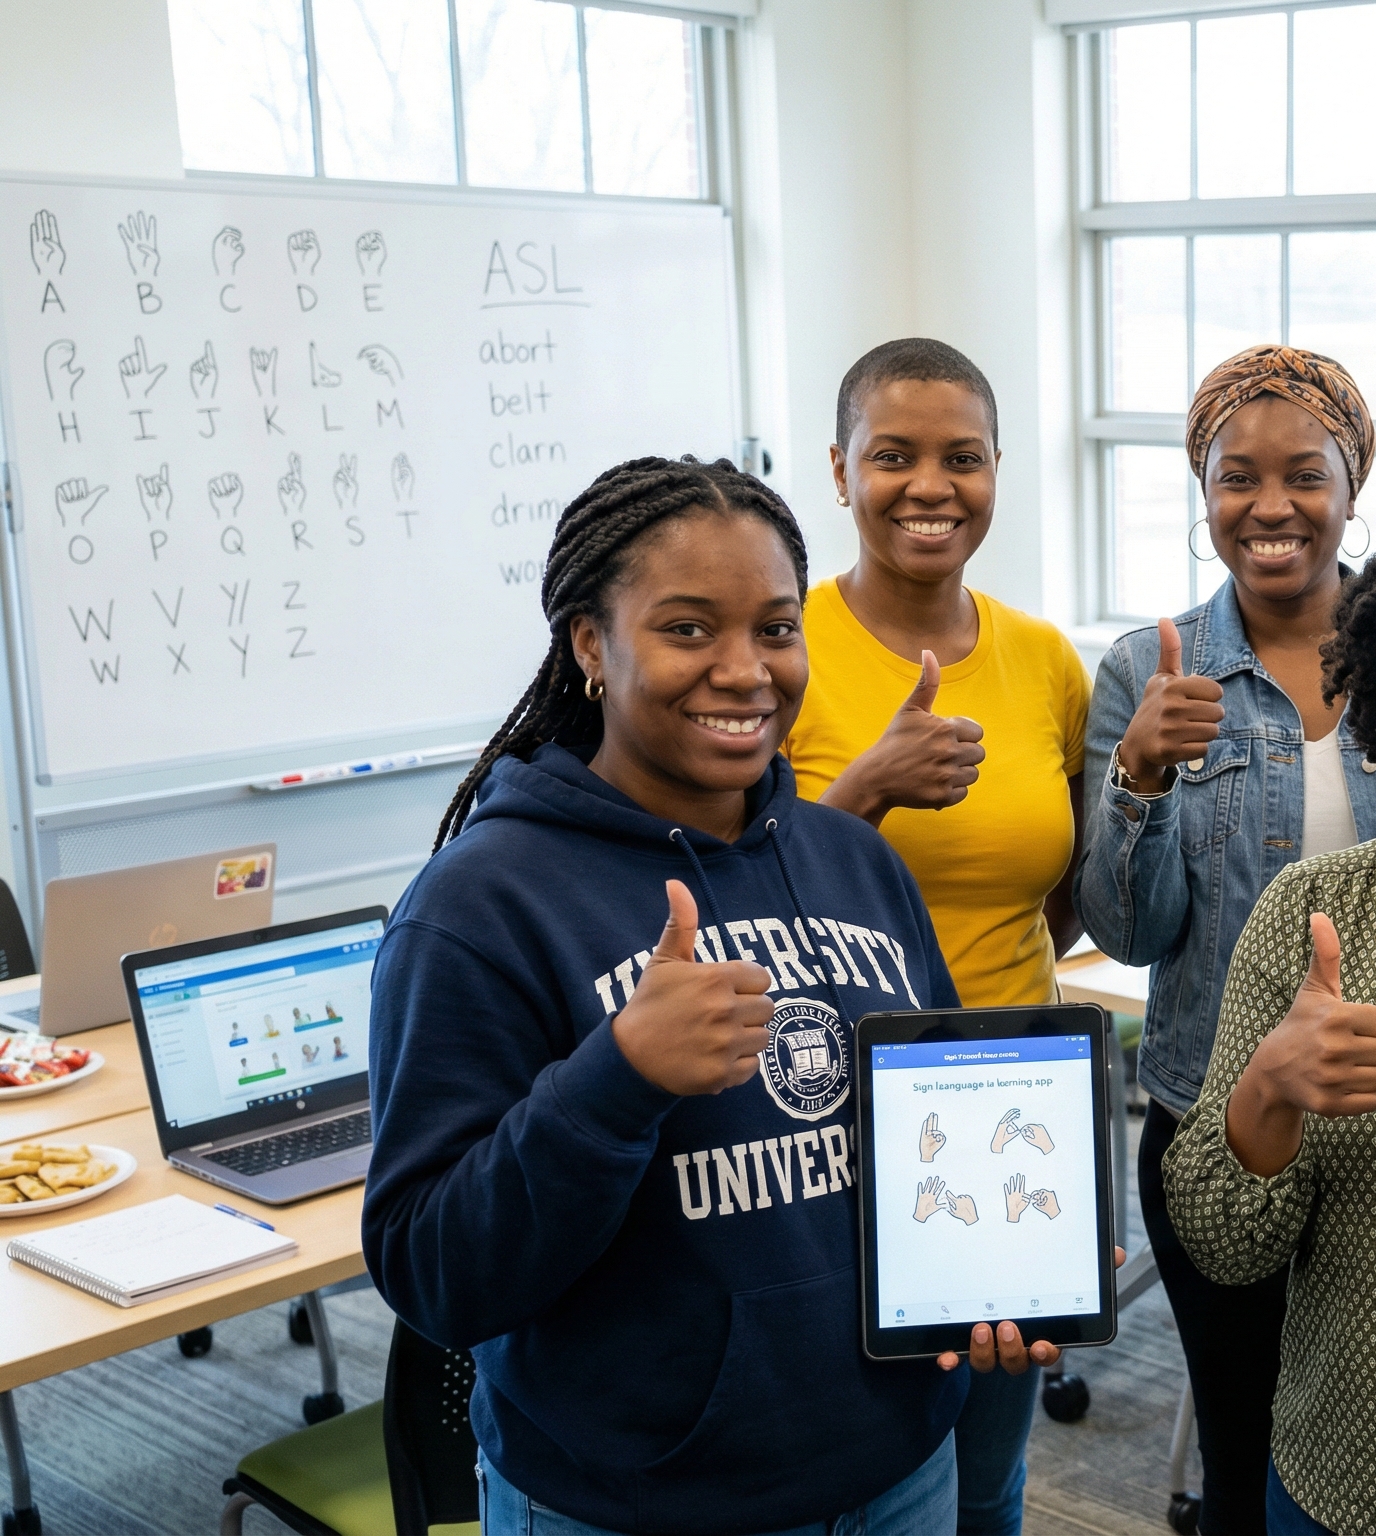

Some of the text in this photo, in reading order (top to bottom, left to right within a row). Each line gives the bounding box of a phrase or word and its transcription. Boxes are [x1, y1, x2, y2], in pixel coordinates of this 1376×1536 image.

[483, 239, 584, 296] ASL
[40, 279, 384, 315] A B C D E
[479, 329, 557, 364] abort
[488, 380, 552, 418] belt
[57, 398, 405, 444] H I J K L M
[491, 491, 567, 528] drim
[68, 510, 419, 565] O P Q R S T
[68, 598, 115, 643] W
[151, 586, 184, 629] V
[282, 580, 307, 610] Z
[166, 642, 192, 676] X
[229, 634, 250, 680] Y
[286, 626, 317, 660] Z
[913, 1082, 934, 1094] Sign
[1034, 1078, 1054, 1087] app
